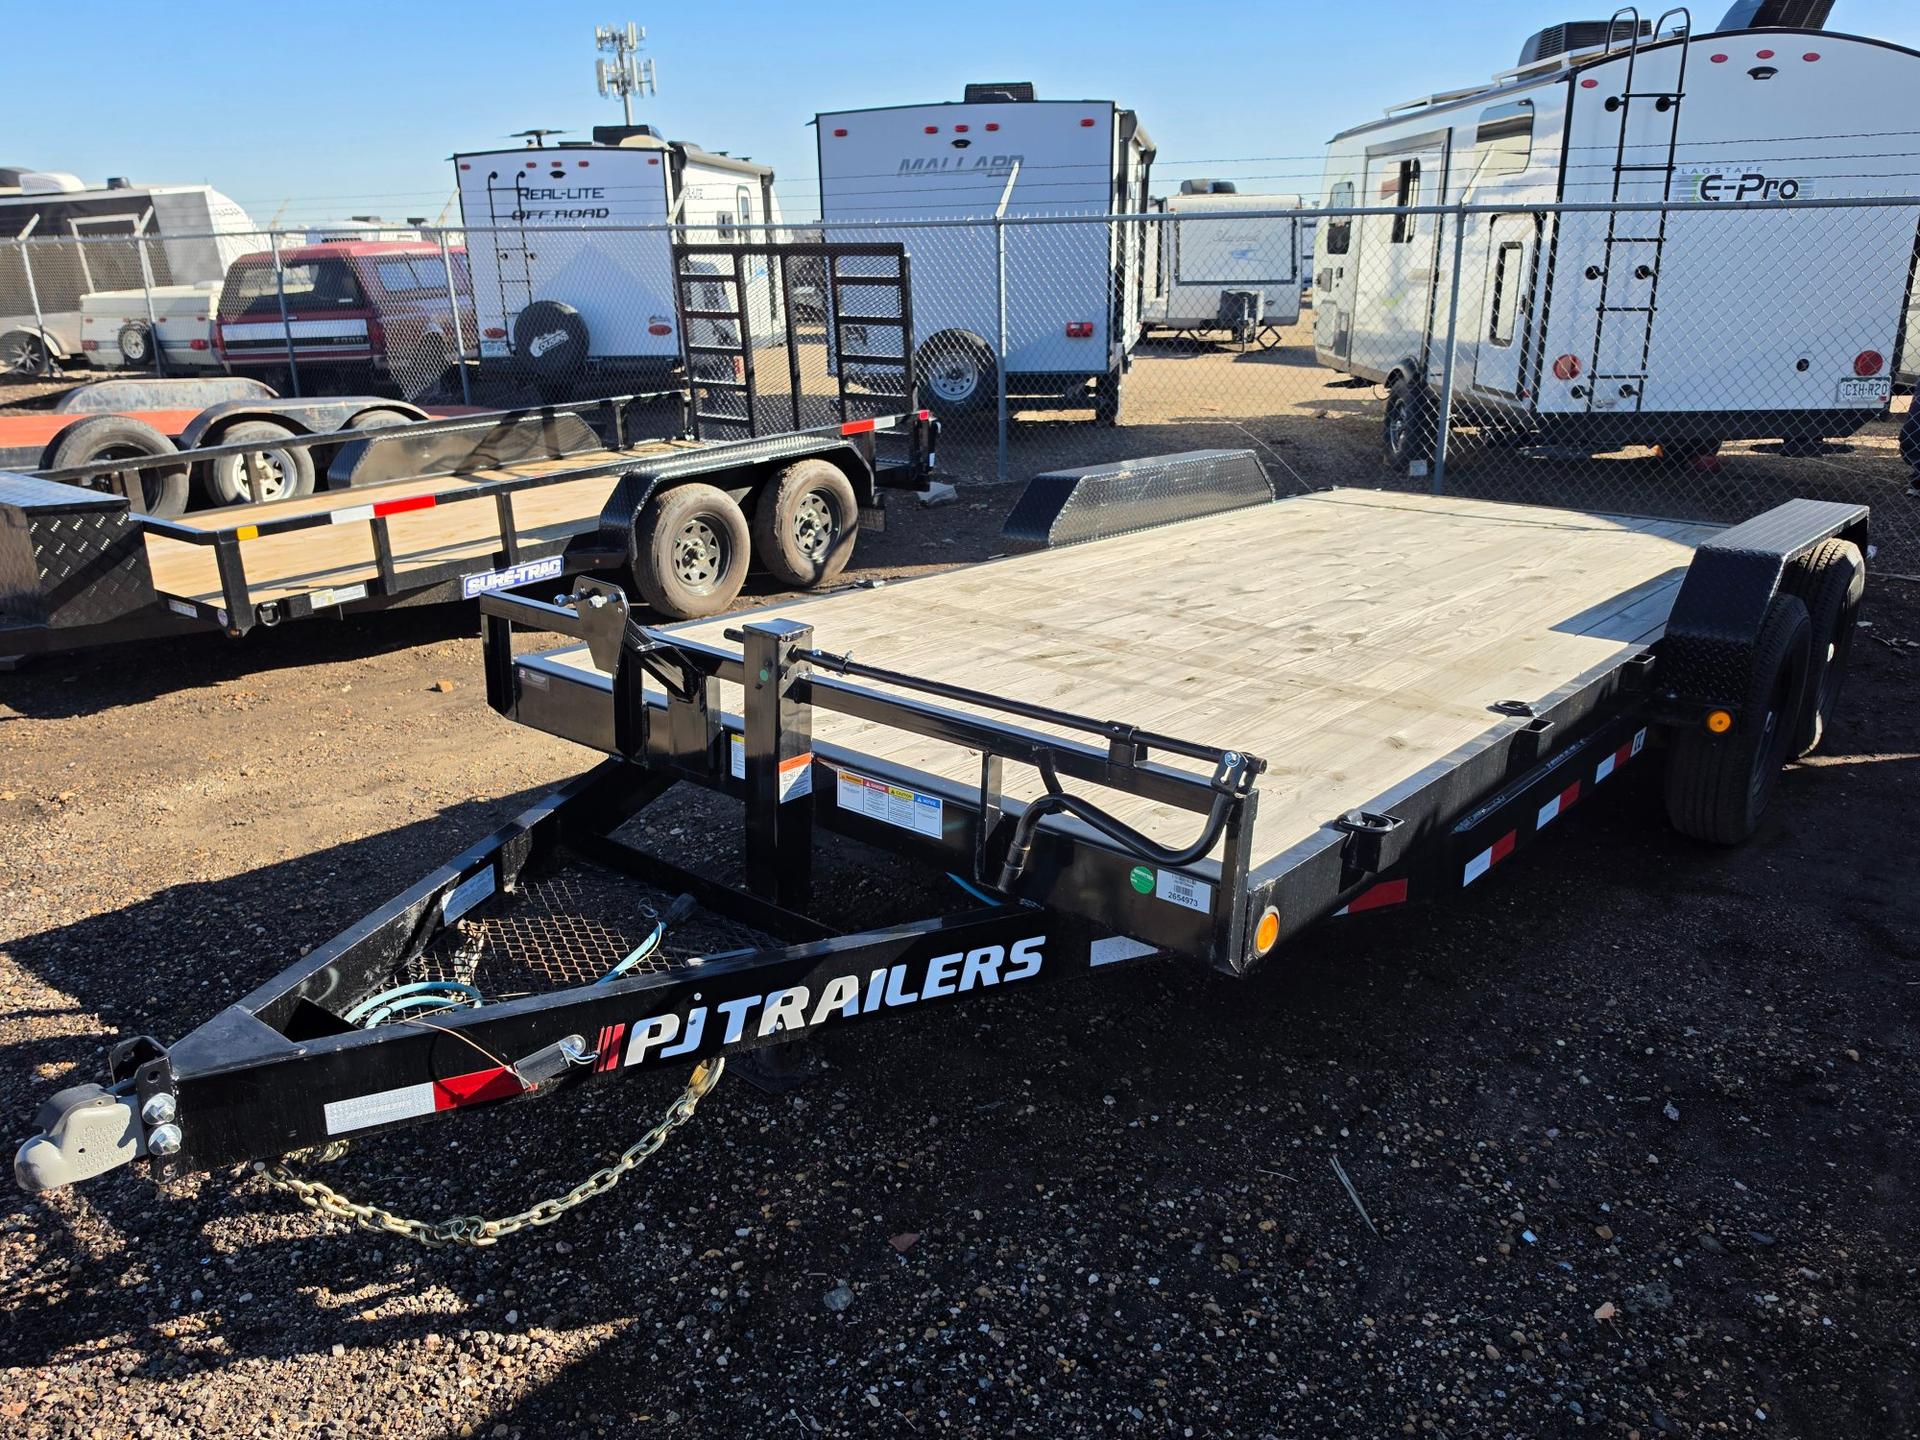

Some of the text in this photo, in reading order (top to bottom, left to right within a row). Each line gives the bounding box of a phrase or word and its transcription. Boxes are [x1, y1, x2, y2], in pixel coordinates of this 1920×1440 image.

[1673, 166, 1763, 175] LAGSTAFF
[518, 187, 605, 201] REAL-LITE
[1700, 174, 1799, 201] E-Pro
[512, 208, 610, 221] OFF ROAD
[467, 559, 562, 595] SURE-TRAC
[624, 935, 1047, 1067] PJ TRAILERS
